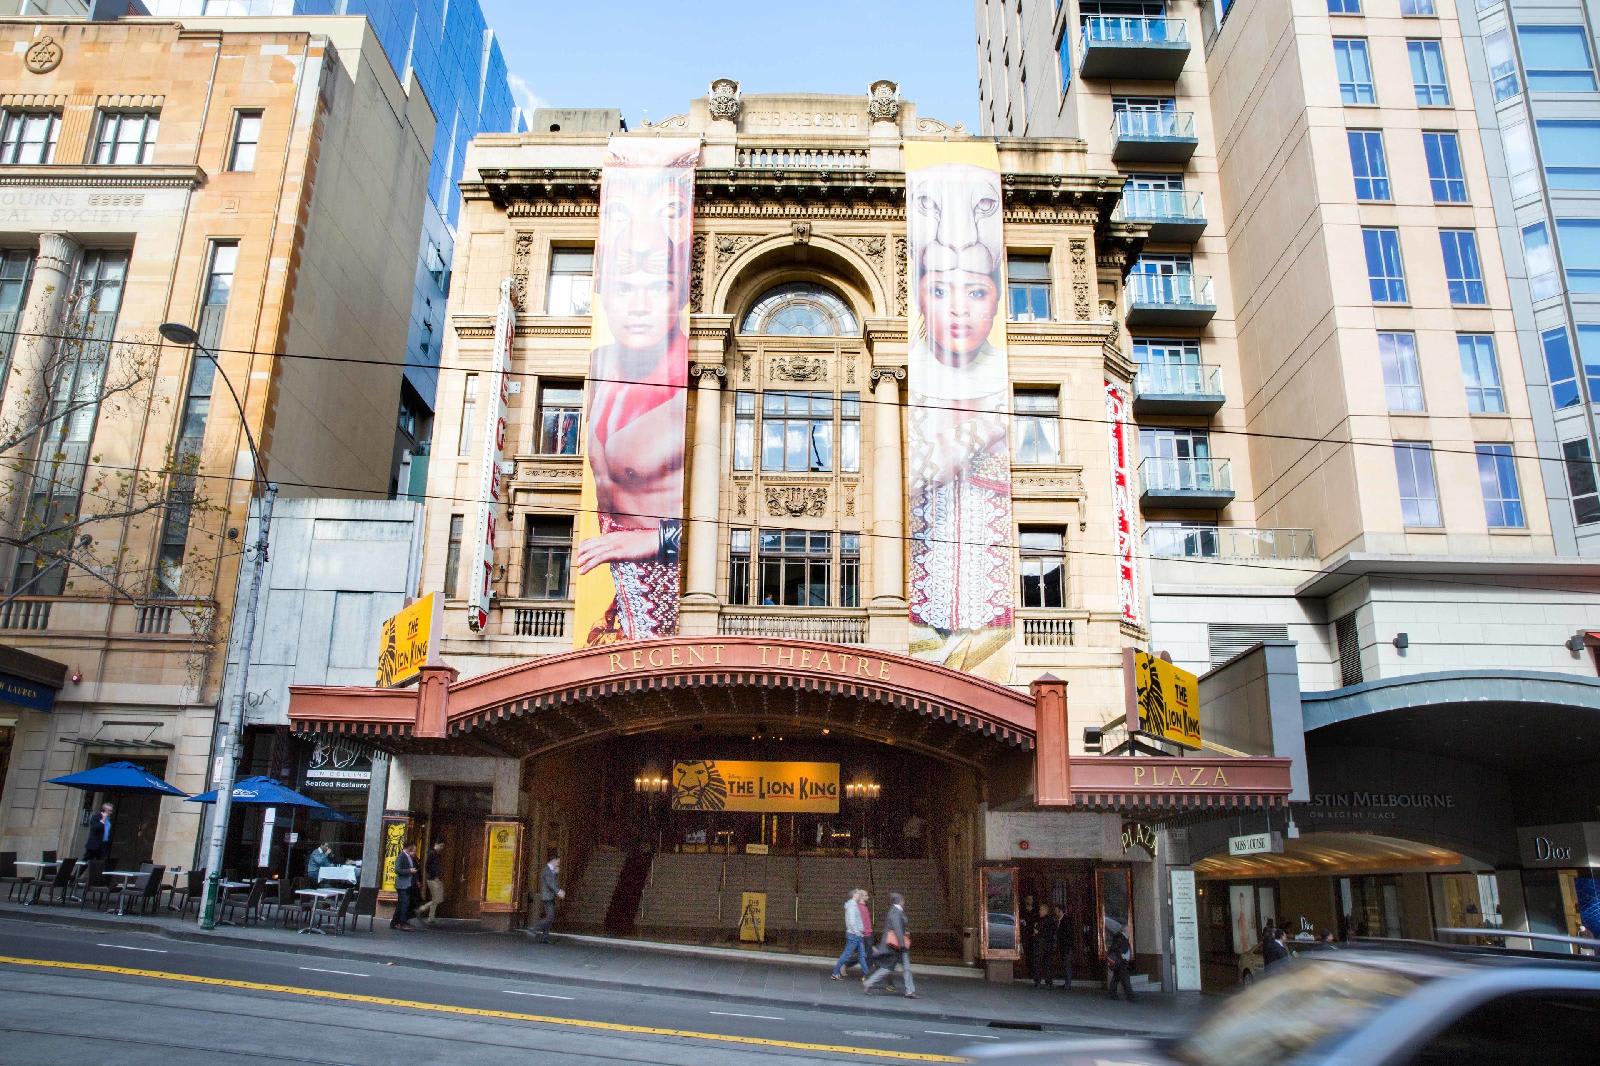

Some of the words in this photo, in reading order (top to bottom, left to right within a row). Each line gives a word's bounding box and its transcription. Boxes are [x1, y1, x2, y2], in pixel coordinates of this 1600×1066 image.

[1, 192, 76, 206] OURNE
[51, 208, 142, 223] SOCIETY
[483, 317, 516, 598] REGENT
[407, 617, 419, 636] THE
[409, 640, 428, 668] KING
[608, 645, 725, 673] REGENT
[758, 646, 892, 681] THEATRE
[1174, 684, 1188, 703] THE
[1164, 702, 1183, 731] LION
[1133, 766, 1229, 786] PLAZA
[728, 780, 754, 795] THE
[759, 776, 795, 800] LION
[800, 776, 836, 800] KING
[1353, 792, 1456, 808] MELBOURNE
[1121, 823, 1158, 855] PLAZA
[1234, 840, 1247, 851] MISS
[1535, 836, 1571, 860] Dior
